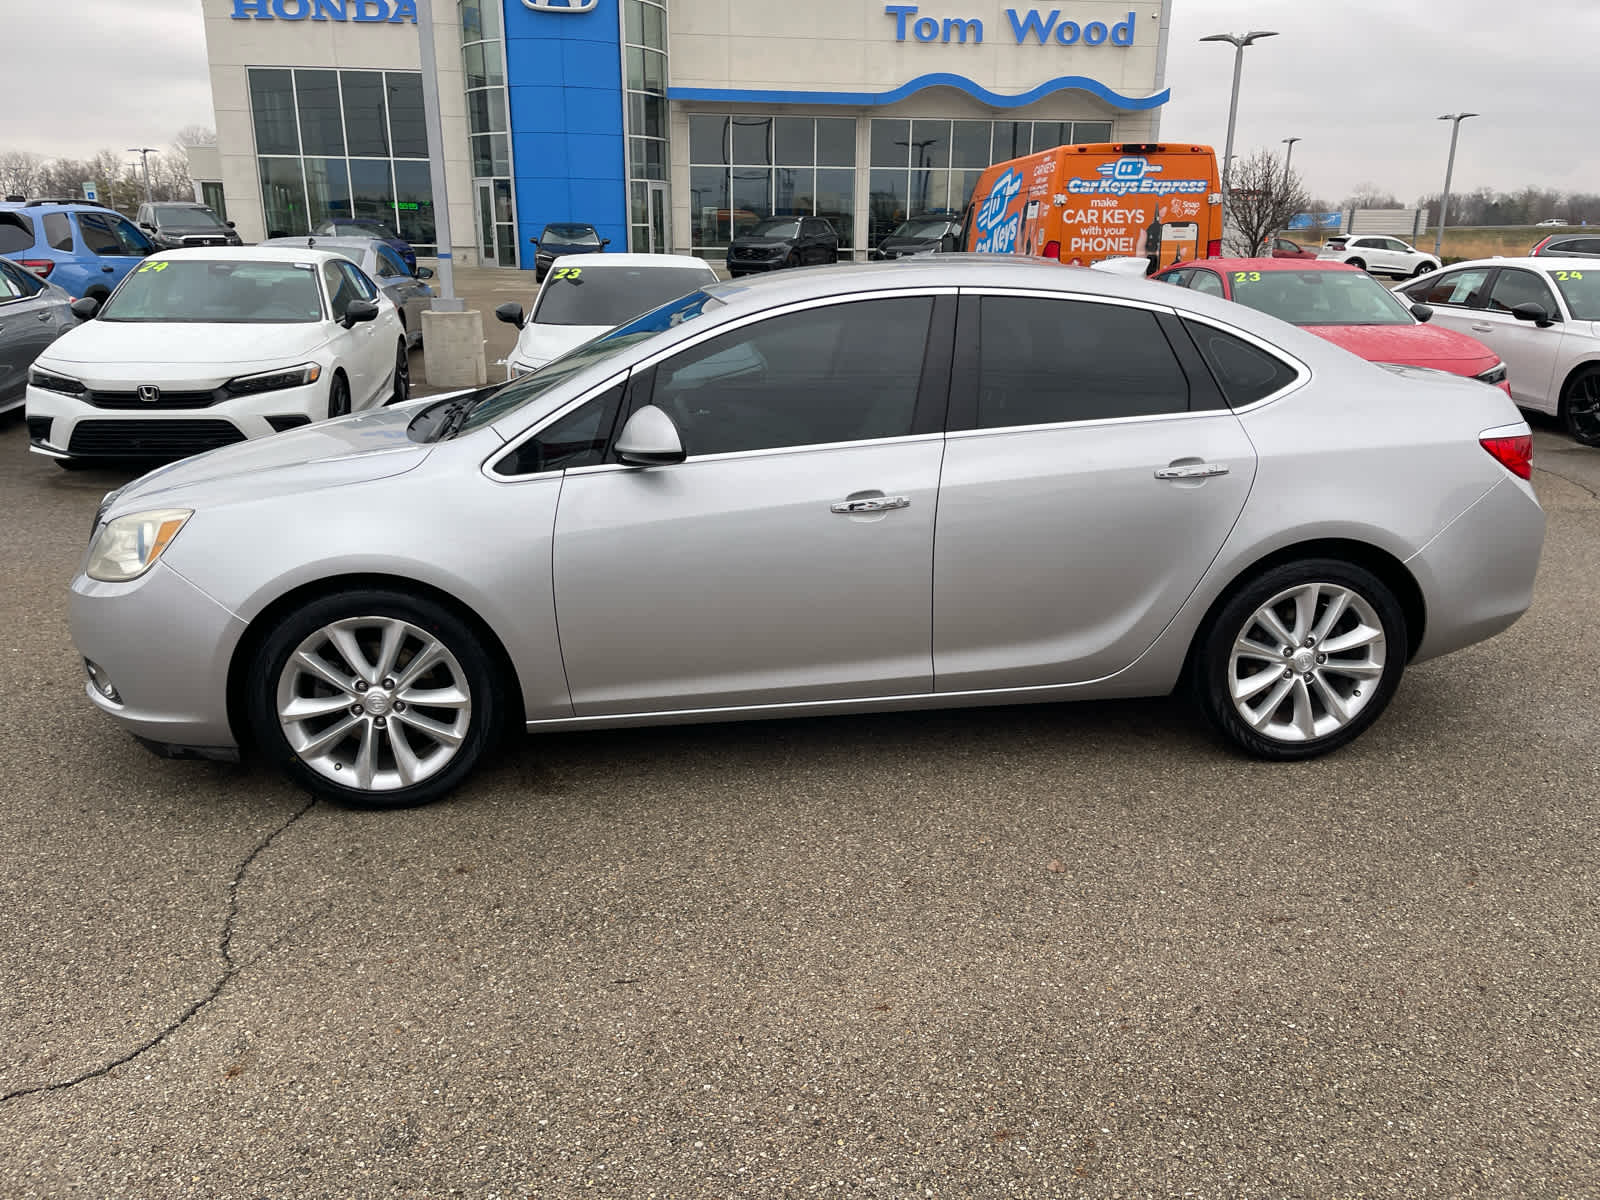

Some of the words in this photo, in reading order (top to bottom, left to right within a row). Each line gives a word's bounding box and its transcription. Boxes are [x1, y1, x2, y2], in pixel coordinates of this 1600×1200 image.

[230, 0, 418, 24] HONDA
[885, 5, 984, 44] Tom
[1006, 8, 1136, 46] Wood
[1068, 179, 1098, 193] Car
[1098, 179, 1139, 195] Keys
[1140, 179, 1207, 195] Express
[1091, 197, 1118, 207] make
[1063, 209, 1098, 224] CAR
[1102, 209, 1145, 224] KEYS
[1080, 226, 1102, 235] with
[1104, 227, 1126, 237] your
[1071, 237, 1134, 252] PHONE!
[137, 261, 168, 273] 24
[553, 267, 582, 280] 23
[1234, 271, 1261, 282] 23
[1555, 271, 1583, 281] 24
